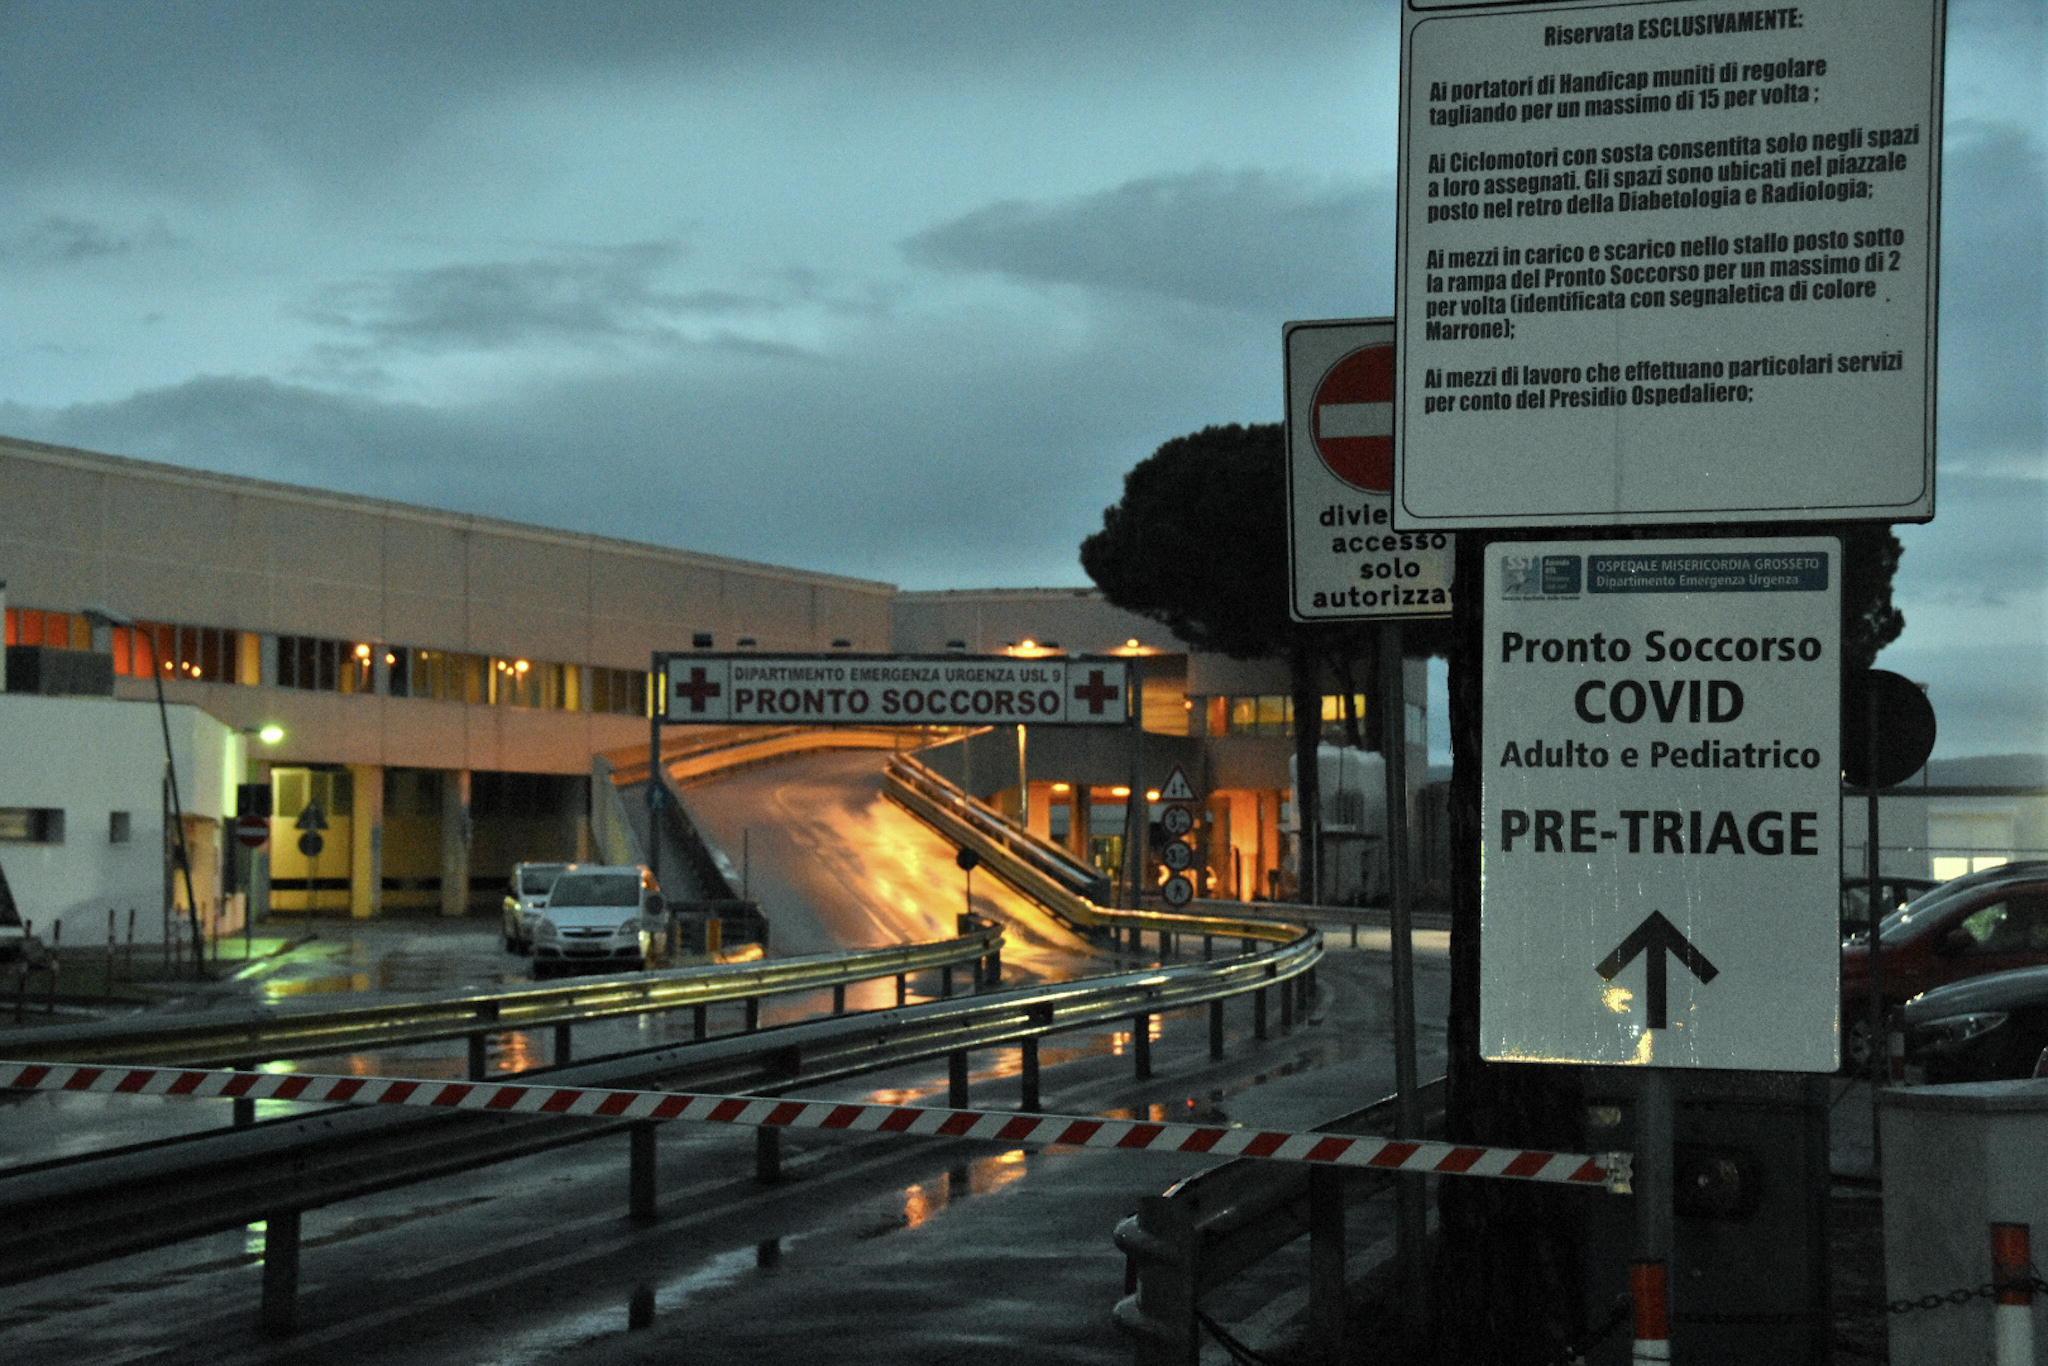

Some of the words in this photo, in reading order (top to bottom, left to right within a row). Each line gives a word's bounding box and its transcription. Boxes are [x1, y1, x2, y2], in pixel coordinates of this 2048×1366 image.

[1544, 22, 1633, 46] Riservata
[1638, 7, 1802, 39] ESCLUSIVAMENTE:
[1429, 81, 1447, 101] Ai
[1451, 75, 1532, 102] portatori
[1537, 74, 1555, 95] di
[1559, 70, 1648, 93] Handicap
[1652, 63, 1714, 87] muniti
[1719, 62, 1737, 83] di
[1742, 58, 1826, 82] regolare
[1429, 102, 1516, 127] tagliando
[1521, 102, 1552, 122] per
[1556, 100, 1580, 118] un
[1584, 92, 1671, 116] massimo
[1675, 90, 1693, 110] di
[1698, 88, 1719, 109] 15
[1724, 89, 1757, 109] per
[1760, 84, 1809, 104] volta
[1428, 153, 1445, 173] Ai
[1450, 146, 1558, 172] Ciclomotori
[1562, 147, 1597, 166] con
[1601, 143, 1653, 164] sosta
[1657, 135, 1760, 160] consentita
[1766, 132, 1807, 154] solo
[1812, 127, 1862, 152] negli
[1867, 123, 1919, 148] spazi
[1428, 181, 1438, 197] a
[1443, 177, 1479, 196] loro
[1483, 170, 1580, 195] assegnati.
[1584, 168, 1609, 189] Gli
[1613, 165, 1662, 189] spazi
[1666, 165, 1713, 184] sono
[1717, 157, 1785, 181] ubicati
[1790, 155, 1821, 177] nel
[1826, 151, 1906, 177] piazzale
[1427, 201, 1478, 223] posto
[1483, 197, 1512, 218] nel
[1516, 197, 1562, 217] retro
[1566, 193, 1613, 214] della
[1618, 185, 1740, 211] Diabetologia
[1745, 187, 1756, 204] e
[1761, 180, 1872, 203] Radiologia;
[1426, 249, 1443, 269] Ai
[1448, 246, 1498, 268] mezzi
[1503, 246, 1520, 265] in
[1524, 243, 1584, 264] carico
[1588, 245, 1599, 261] e
[1604, 239, 1675, 261] scarico
[1680, 235, 1728, 257] nello
[1733, 232, 1788, 254] stallo
[1793, 230, 1848, 253] posto
[1853, 227, 1904, 248] sotto
[1426, 273, 1442, 293] la
[1447, 273, 1506, 292] rampa
[1510, 268, 1540, 289] del
[1544, 267, 1605, 287] Pronto
[1610, 264, 1699, 285] Soccorso
[1703, 262, 1736, 282] per
[1740, 261, 1764, 278] un
[1770, 254, 1860, 277] massimo
[1864, 251, 1883, 272] di
[1888, 249, 1900, 271] 2
[1426, 300, 1457, 319] per
[1460, 295, 1505, 315] volta
[1630, 290, 1664, 308] con
[1669, 282, 1784, 307] segnaletica
[1789, 280, 1807, 300] di
[1812, 279, 1875, 300] colore
[1424, 368, 1441, 388] Ai
[1446, 366, 1496, 387] mezzi
[1501, 365, 1518, 386] di
[1523, 365, 1581, 385] lavoro
[1585, 362, 1620, 382] che
[1624, 360, 1723, 381] effettuano
[1728, 353, 1832, 379] particolari
[1837, 350, 1902, 372] servizi
[1424, 395, 1455, 414] per
[1459, 391, 1511, 411] conto
[1516, 388, 1545, 409] del
[1549, 386, 1627, 408] Presidio
[1631, 383, 1752, 406] Ospedaliero;
[1319, 503, 1387, 526] divie
[1332, 534, 1446, 553] accesso
[1360, 557, 1419, 579] solo
[1596, 559, 1657, 573] OSPEDALE
[1661, 559, 1750, 571] MISERICORDIA
[1754, 558, 1818, 569] GROSSETO
[1596, 575, 1675, 588] Dipartimento
[1679, 575, 1745, 588] Emergenza
[1749, 574, 1798, 588] Urgenza
[1313, 584, 1451, 608] autorizza
[1502, 631, 1630, 662] Pronto
[1645, 630, 1821, 662] Soccorso
[734, 666, 844, 681] DIPARTIMENTO
[850, 667, 939, 681] EMERGENZA
[945, 668, 1015, 682] URGENZA
[1019, 669, 1047, 682] USL
[1052, 669, 1060, 682] 9
[735, 688, 869, 714] PRONTO
[881, 688, 1059, 715] SOCCORSO
[1574, 679, 1743, 723] COVID
[1500, 739, 1608, 767] Adulto
[1620, 747, 1638, 767] e
[1650, 739, 1820, 768] Pediatrico
[1501, 809, 1818, 855] PRE-TRIAGE
